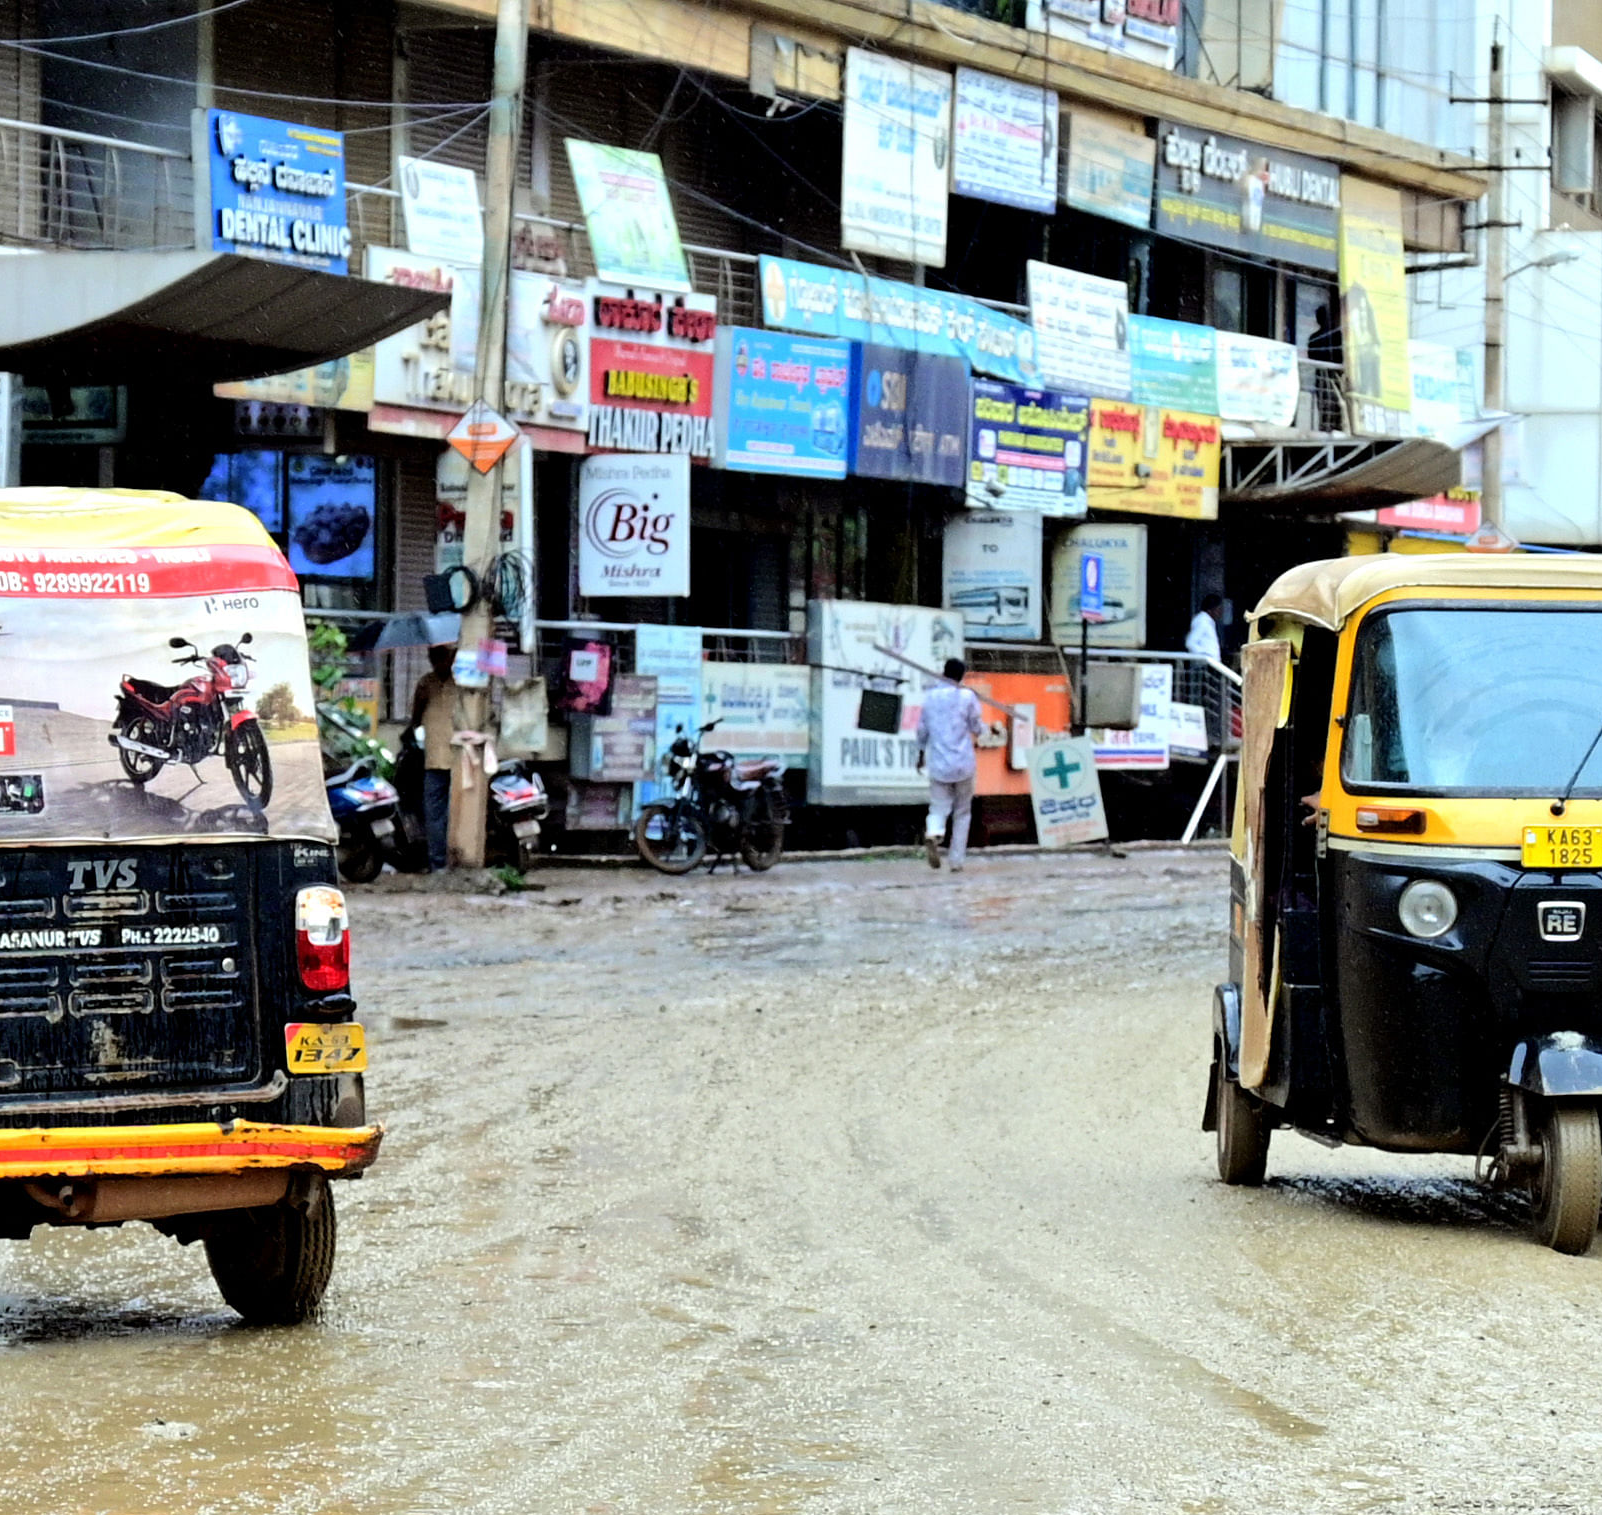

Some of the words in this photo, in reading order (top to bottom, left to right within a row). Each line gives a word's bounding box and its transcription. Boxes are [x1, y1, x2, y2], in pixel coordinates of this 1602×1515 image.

[222, 208, 291, 248] DENTAL
[293, 219, 352, 258] CLINIC
[588, 405, 659, 453] THAKUR
[661, 412, 716, 458] PEDHA
[606, 503, 676, 556] Big
[982, 544, 998, 553] TO
[601, 562, 662, 578] Mishra
[34, 573, 151, 593] 9289922119
[223, 597, 259, 610] Hero
[841, 737, 895, 768] PAUL'S
[1548, 829, 1593, 846] KA63
[1550, 848, 1593, 865] 1825
[67, 858, 138, 889] TVS
[1547, 914, 1577, 934] RE
